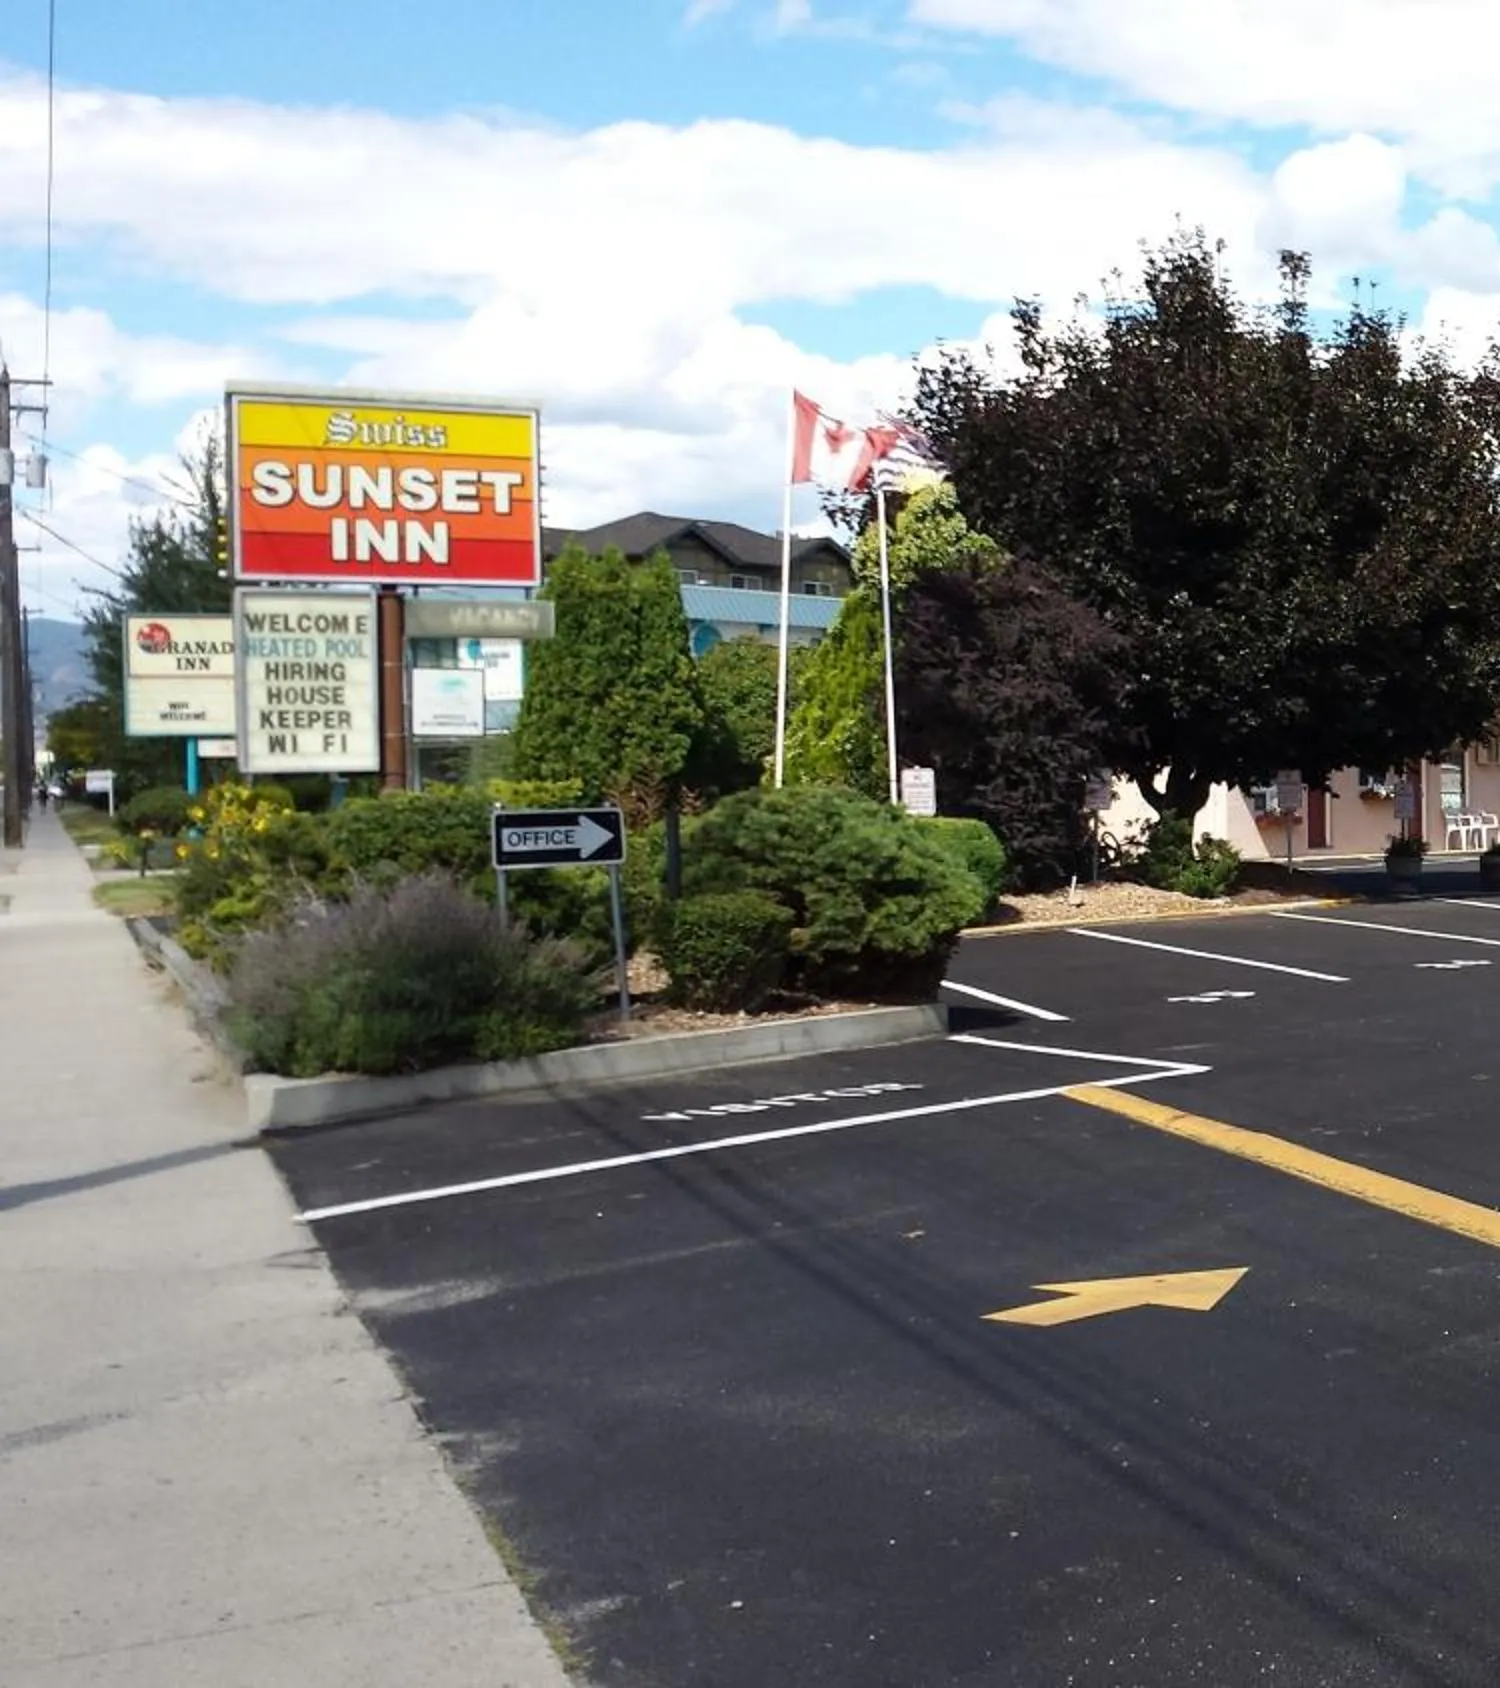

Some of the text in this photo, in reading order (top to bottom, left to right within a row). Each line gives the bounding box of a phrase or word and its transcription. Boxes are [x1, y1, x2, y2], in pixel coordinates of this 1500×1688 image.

[323, 410, 448, 447] Swiss
[252, 460, 524, 515] SUNSET
[329, 517, 450, 565] INN
[244, 613, 368, 634] WELCOME
[245, 636, 368, 658] HEATED POOL
[176, 657, 211, 671] INN
[264, 661, 346, 682] HIRING
[267, 686, 345, 705] HOUSE
[260, 709, 352, 730] KEEPER
[268, 733, 347, 753] WI FI
[507, 829, 576, 848] OFFICE
[640, 1082, 924, 1121] VISITOR
